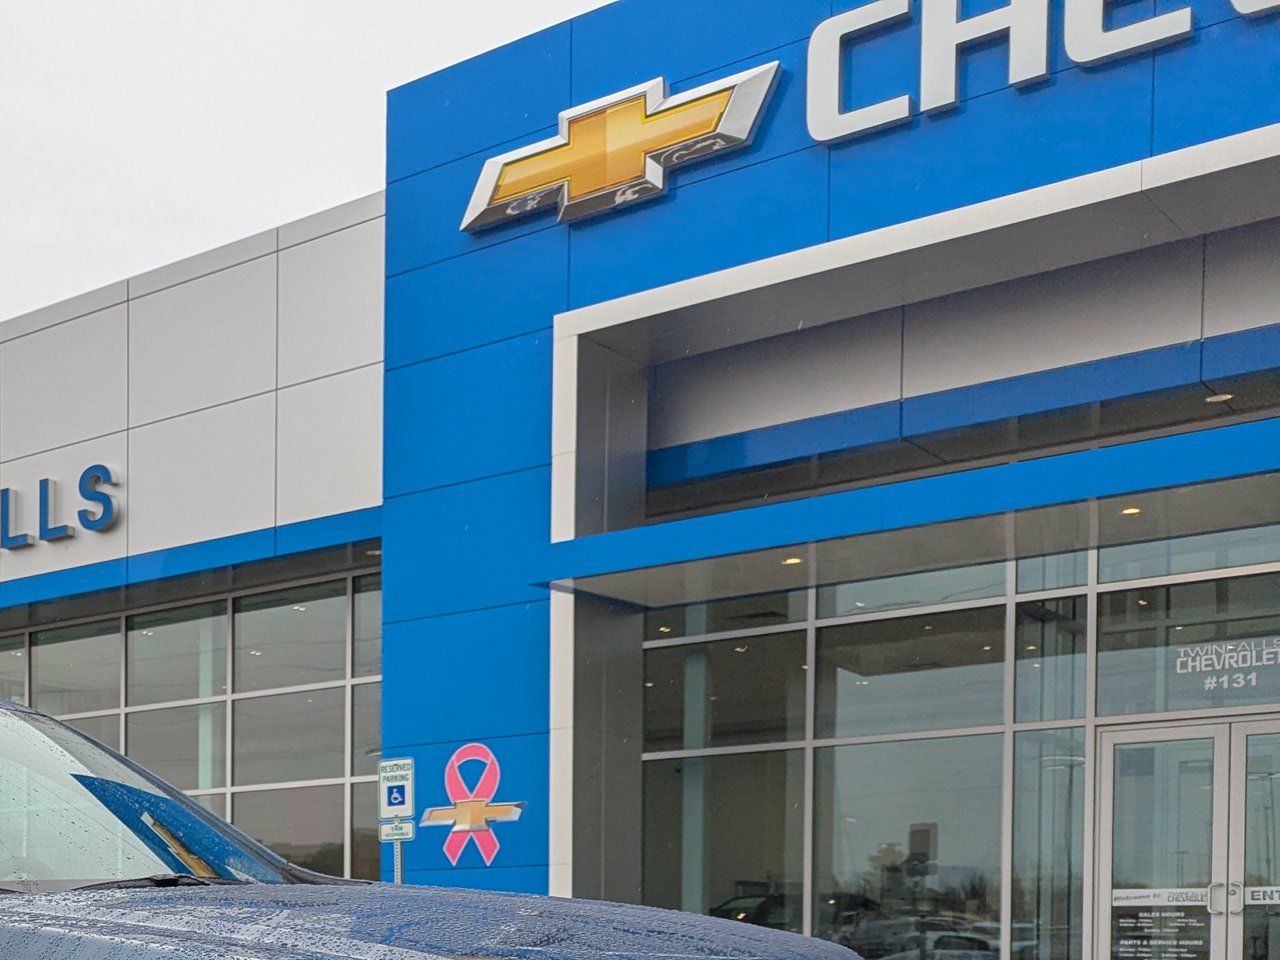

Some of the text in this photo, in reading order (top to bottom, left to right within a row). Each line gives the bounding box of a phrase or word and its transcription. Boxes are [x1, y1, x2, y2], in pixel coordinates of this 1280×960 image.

[806, 0, 1280, 145] CH
[1177, 648, 1280, 673] CHEVROLE
[1204, 672, 1257, 690] #131
[381, 764, 411, 773] RESERVED
[383, 774, 409, 783] PARKING
